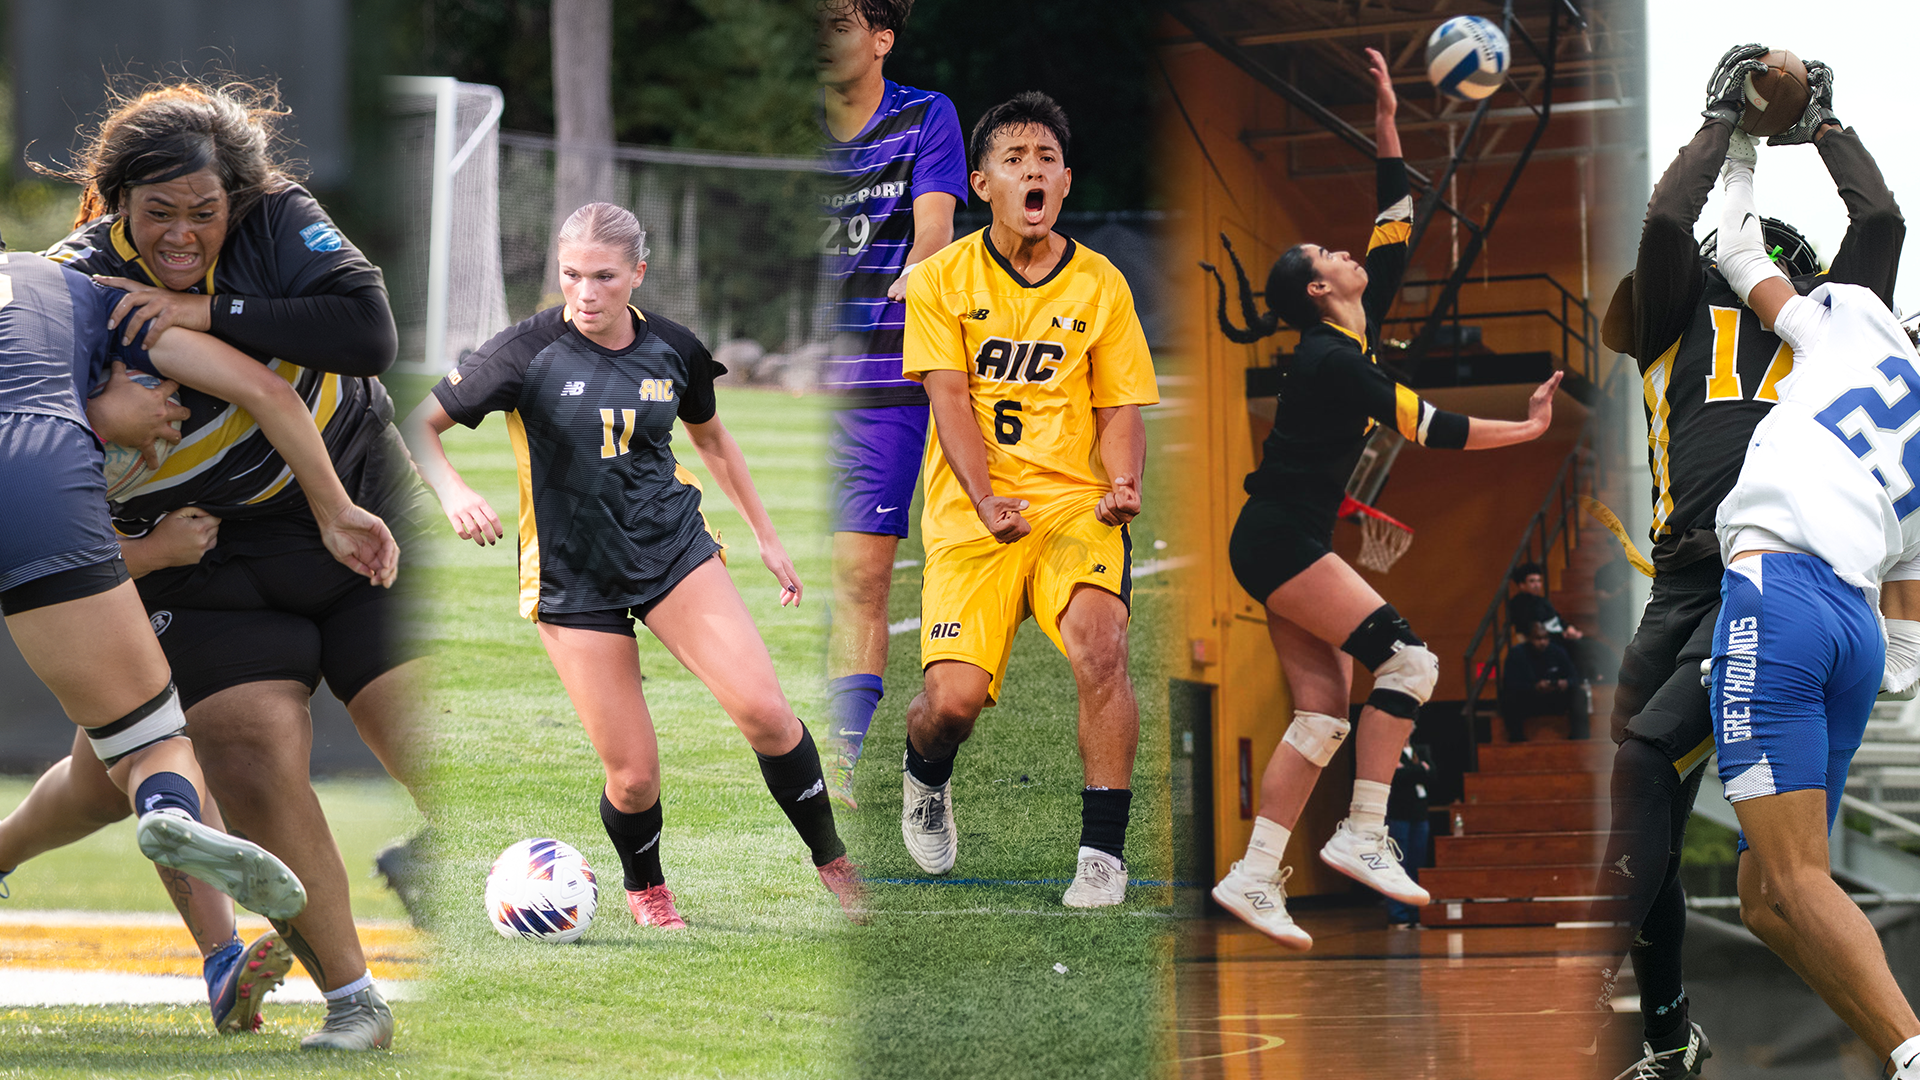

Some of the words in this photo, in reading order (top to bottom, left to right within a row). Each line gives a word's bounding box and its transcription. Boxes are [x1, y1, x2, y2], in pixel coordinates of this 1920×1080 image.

[817, 213, 870, 256] 29
[1051, 315, 1087, 334] NE10
[973, 336, 1067, 385] AIC
[639, 379, 674, 402] AIC
[599, 408, 636, 459] 11
[993, 399, 1023, 446] 6
[930, 622, 961, 640] AIC
[1722, 616, 1759, 744] GREYHOUNDS
[1683, 1028, 1700, 1072] NIKE
